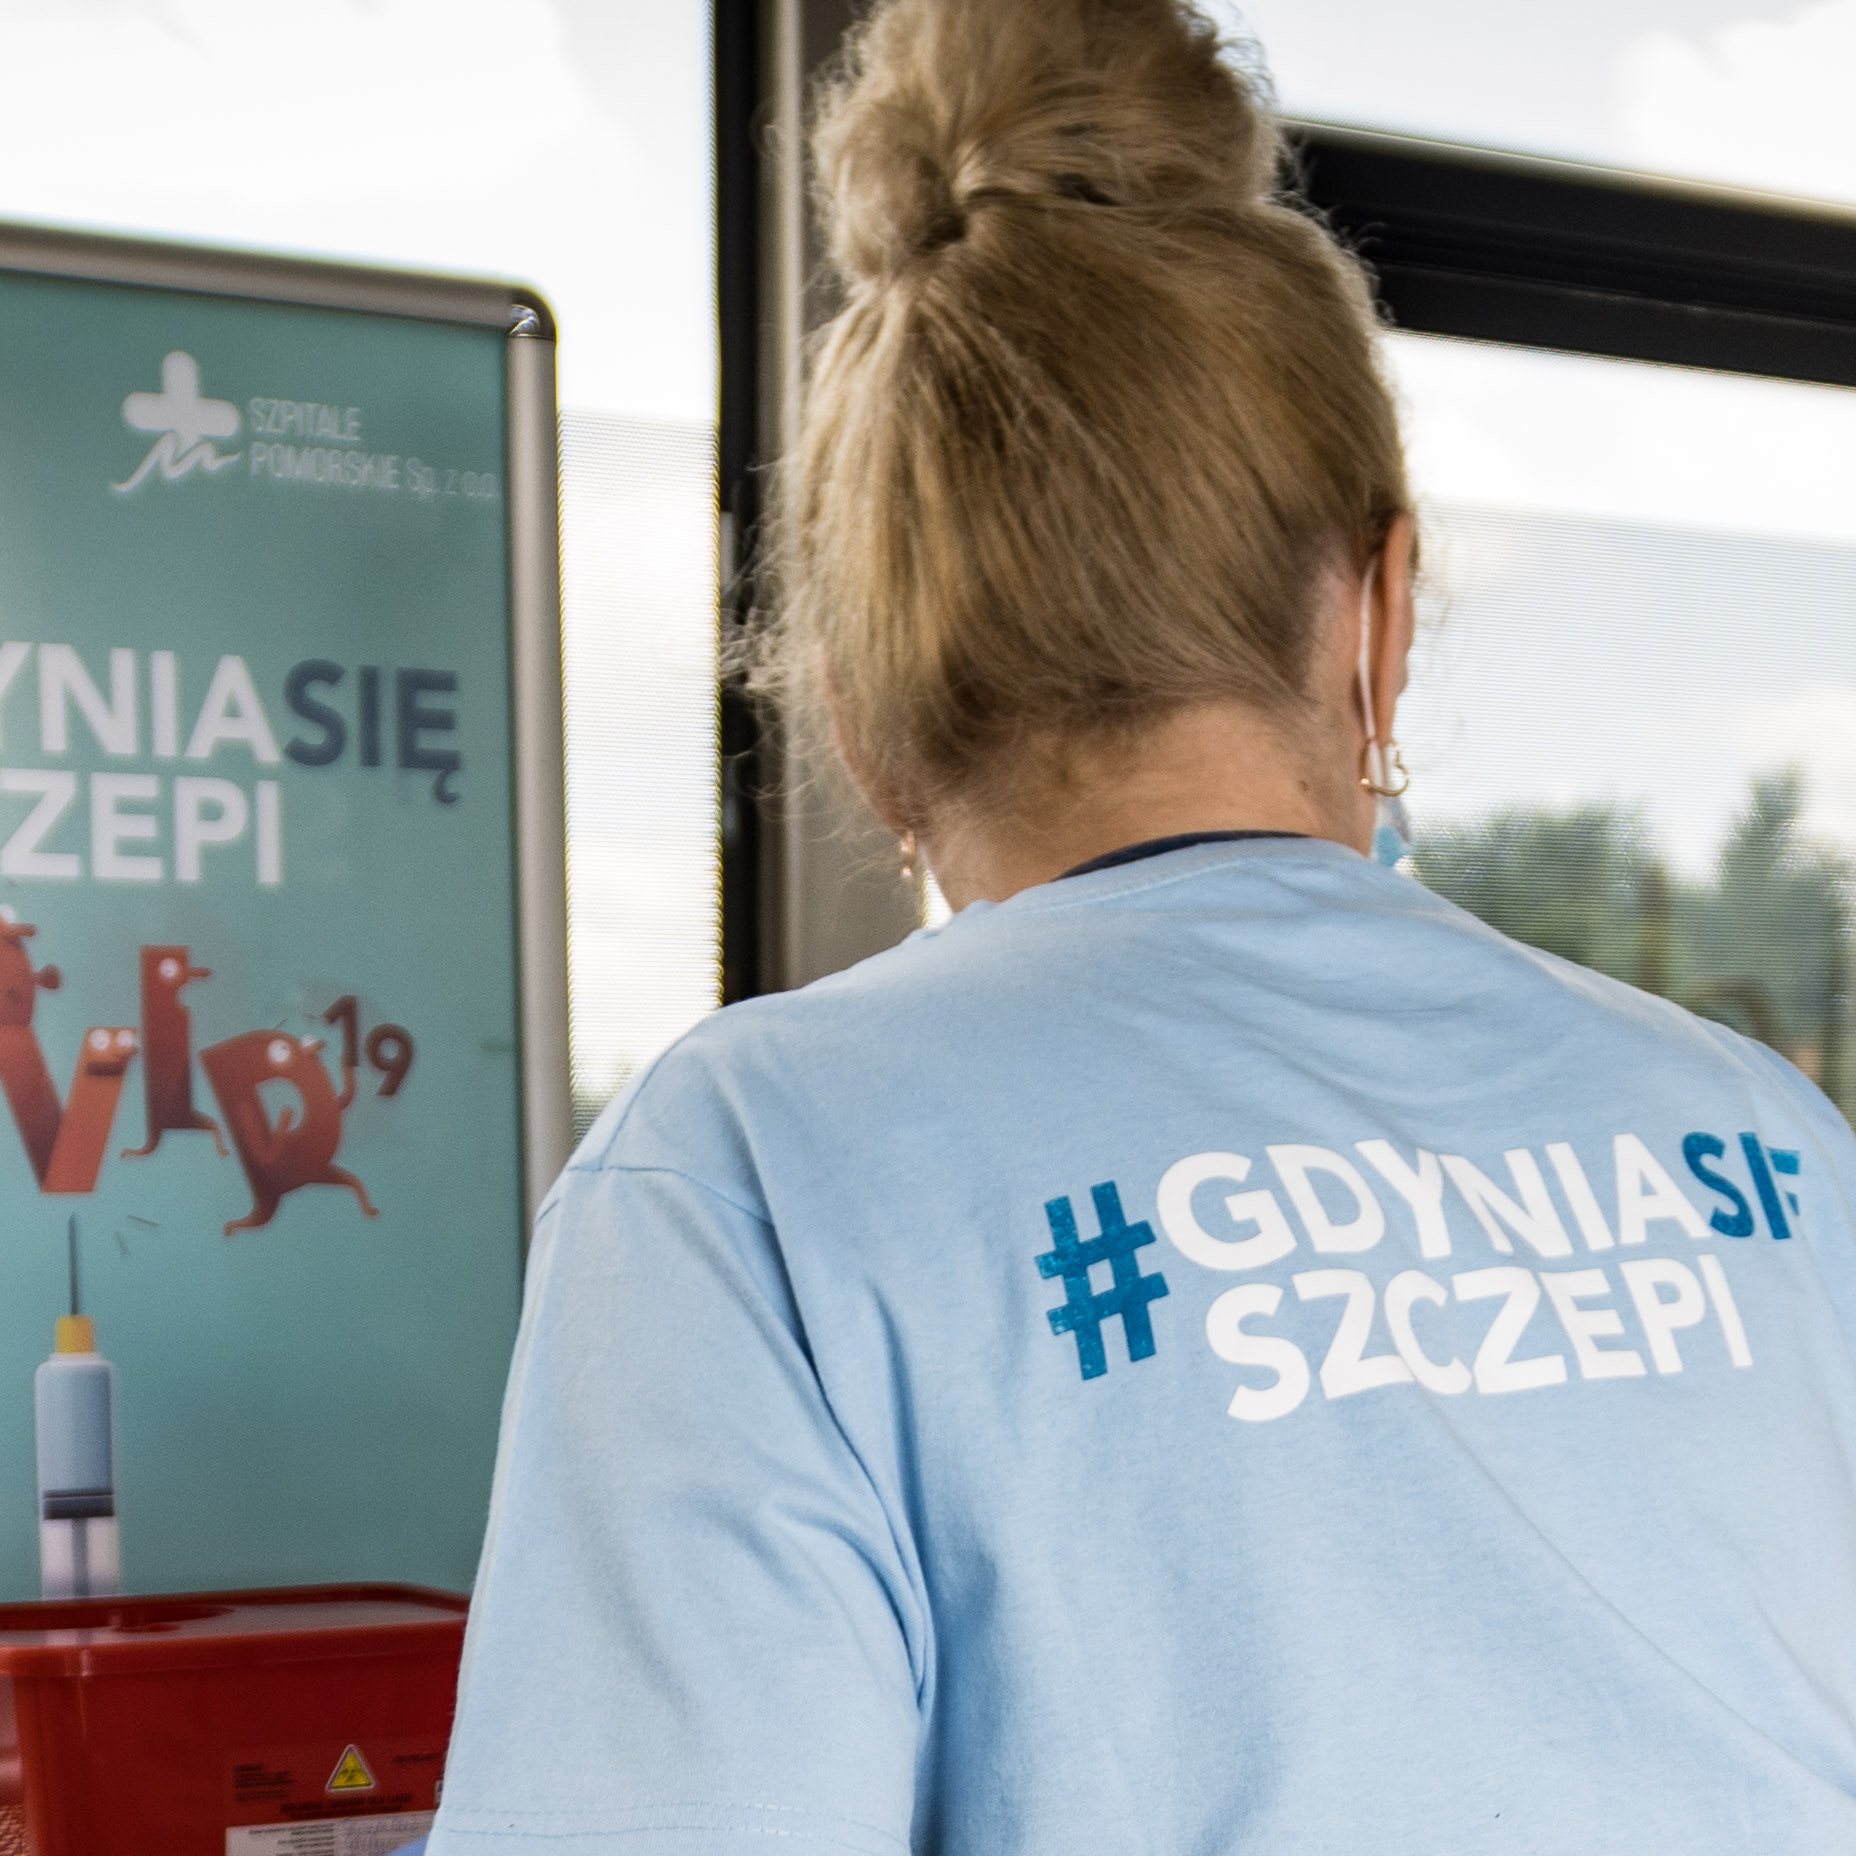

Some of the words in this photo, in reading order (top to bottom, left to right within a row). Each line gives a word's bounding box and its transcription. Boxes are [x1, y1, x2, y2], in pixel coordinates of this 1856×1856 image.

[250, 397, 363, 441] SZPITALE
[250, 441, 400, 490] POMORSKIE
[322, 994, 416, 1098] 19
[1205, 1252, 1755, 1423] SZCZEPI
